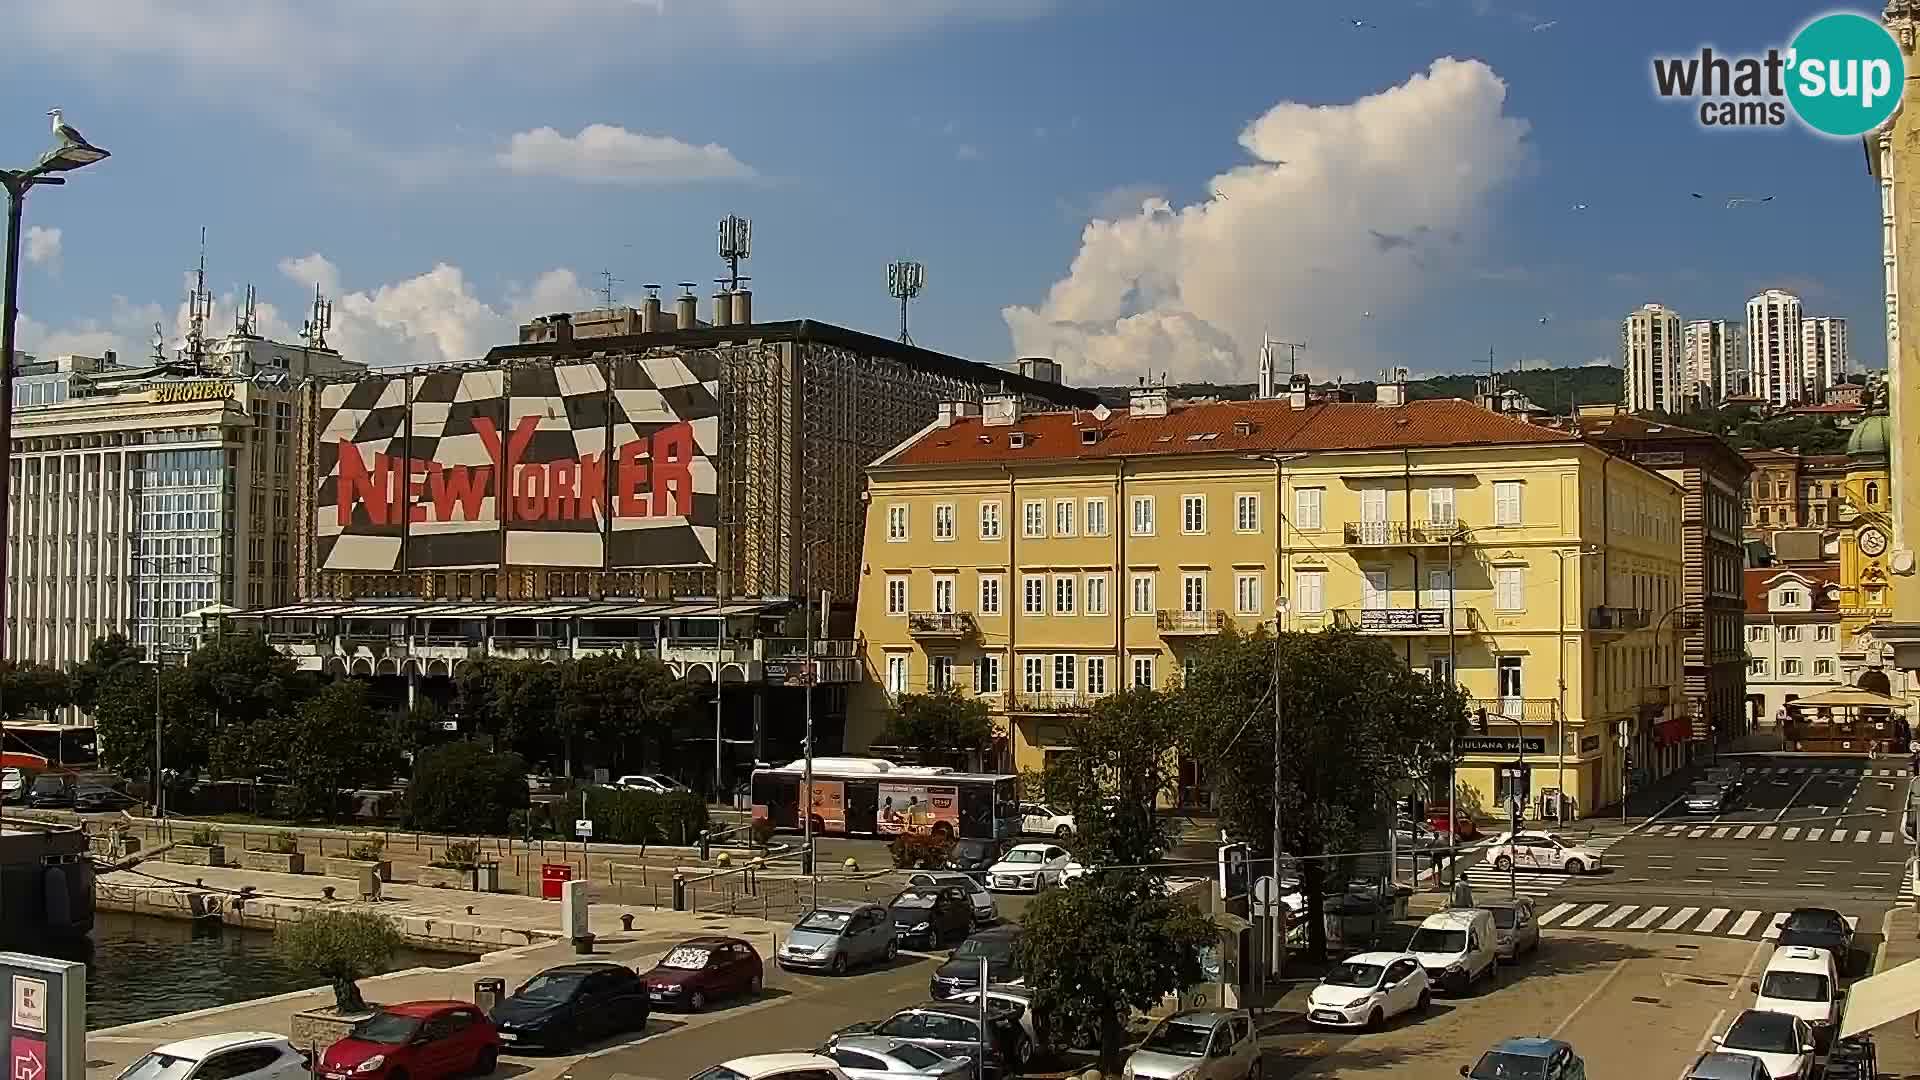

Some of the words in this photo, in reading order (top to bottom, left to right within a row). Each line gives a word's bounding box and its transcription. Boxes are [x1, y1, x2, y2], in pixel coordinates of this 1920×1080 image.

[337, 436, 491, 526] NEW
[472, 415, 693, 522] YORKER
[1457, 740, 1504, 750] JULIANA
[1507, 742, 1539, 750] NAILS
